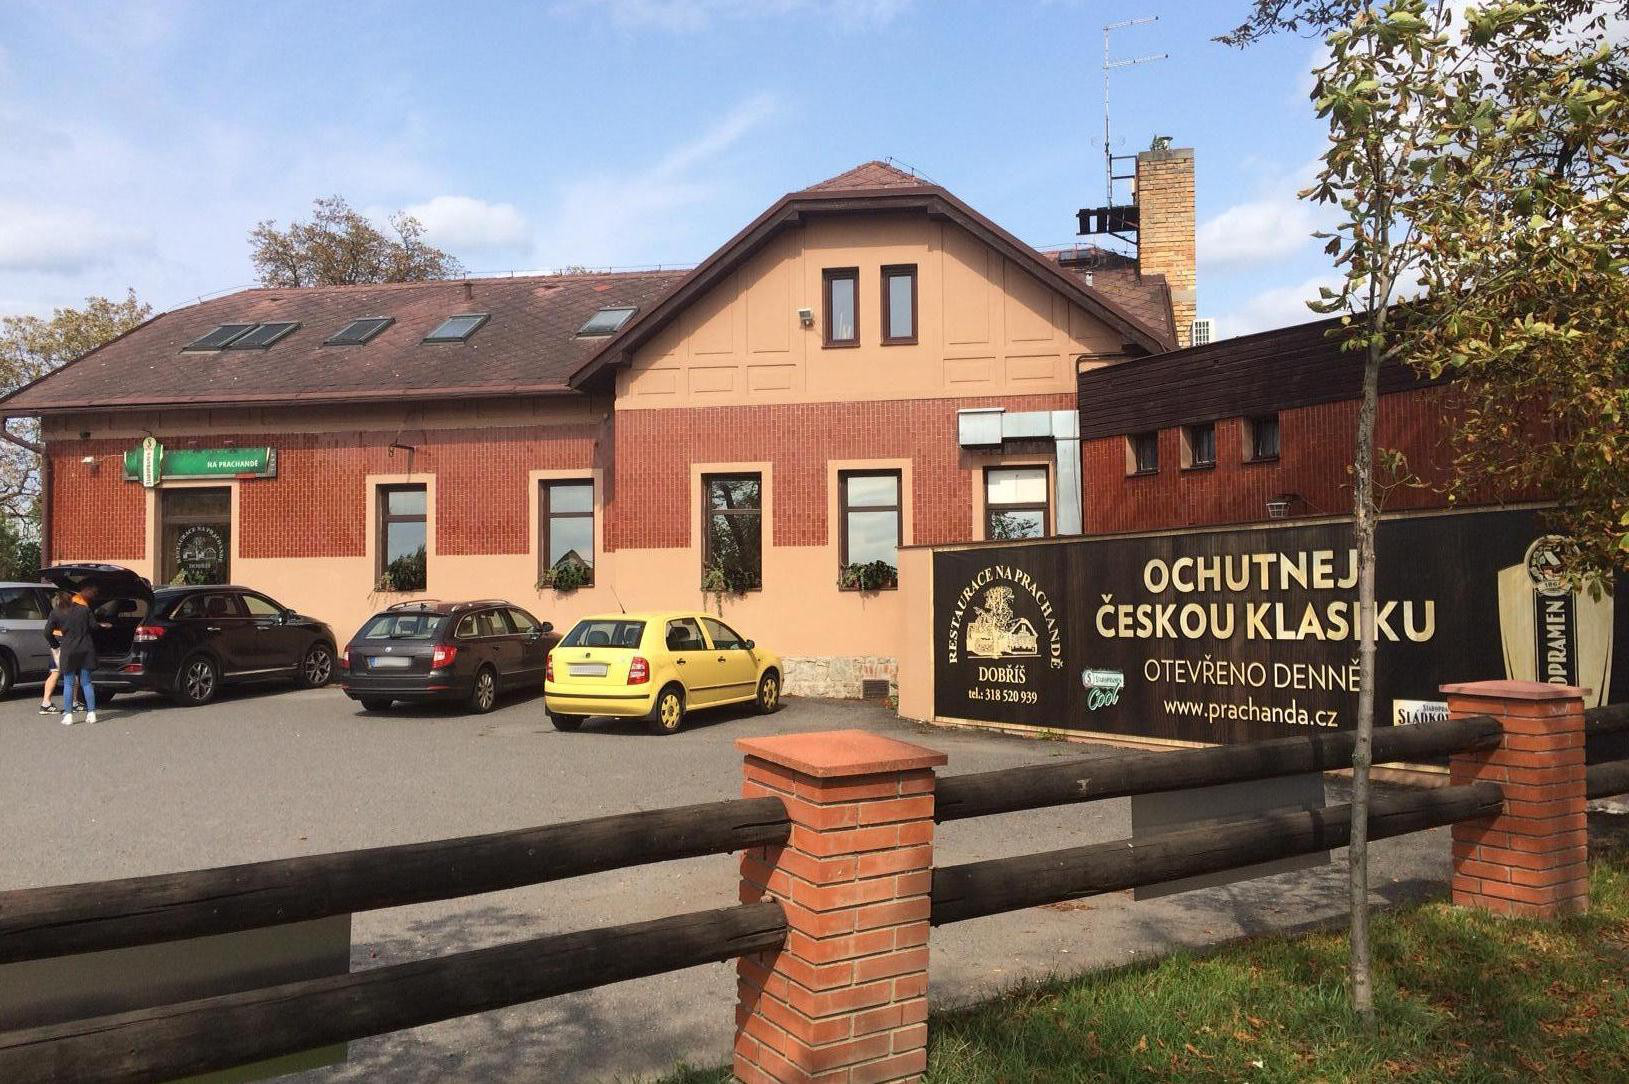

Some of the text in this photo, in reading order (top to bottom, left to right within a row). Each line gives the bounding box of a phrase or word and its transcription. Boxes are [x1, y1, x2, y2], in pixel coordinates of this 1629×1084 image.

[1143, 549, 1358, 593] OCHUTNEJ
[949, 565, 1063, 669] RESTAURACE NA PRACHANDĚ
[1096, 593, 1436, 643] ČESKOU KLASIKU
[978, 664, 1026, 684] DOBŘÍŠ
[1144, 654, 1361, 692] OTEVŘENO DENNĚ
[968, 687, 1038, 704] tel.: 318 520 939
[1087, 684, 1120, 711] Cool
[1163, 696, 1338, 728] www.prachanda.cz
